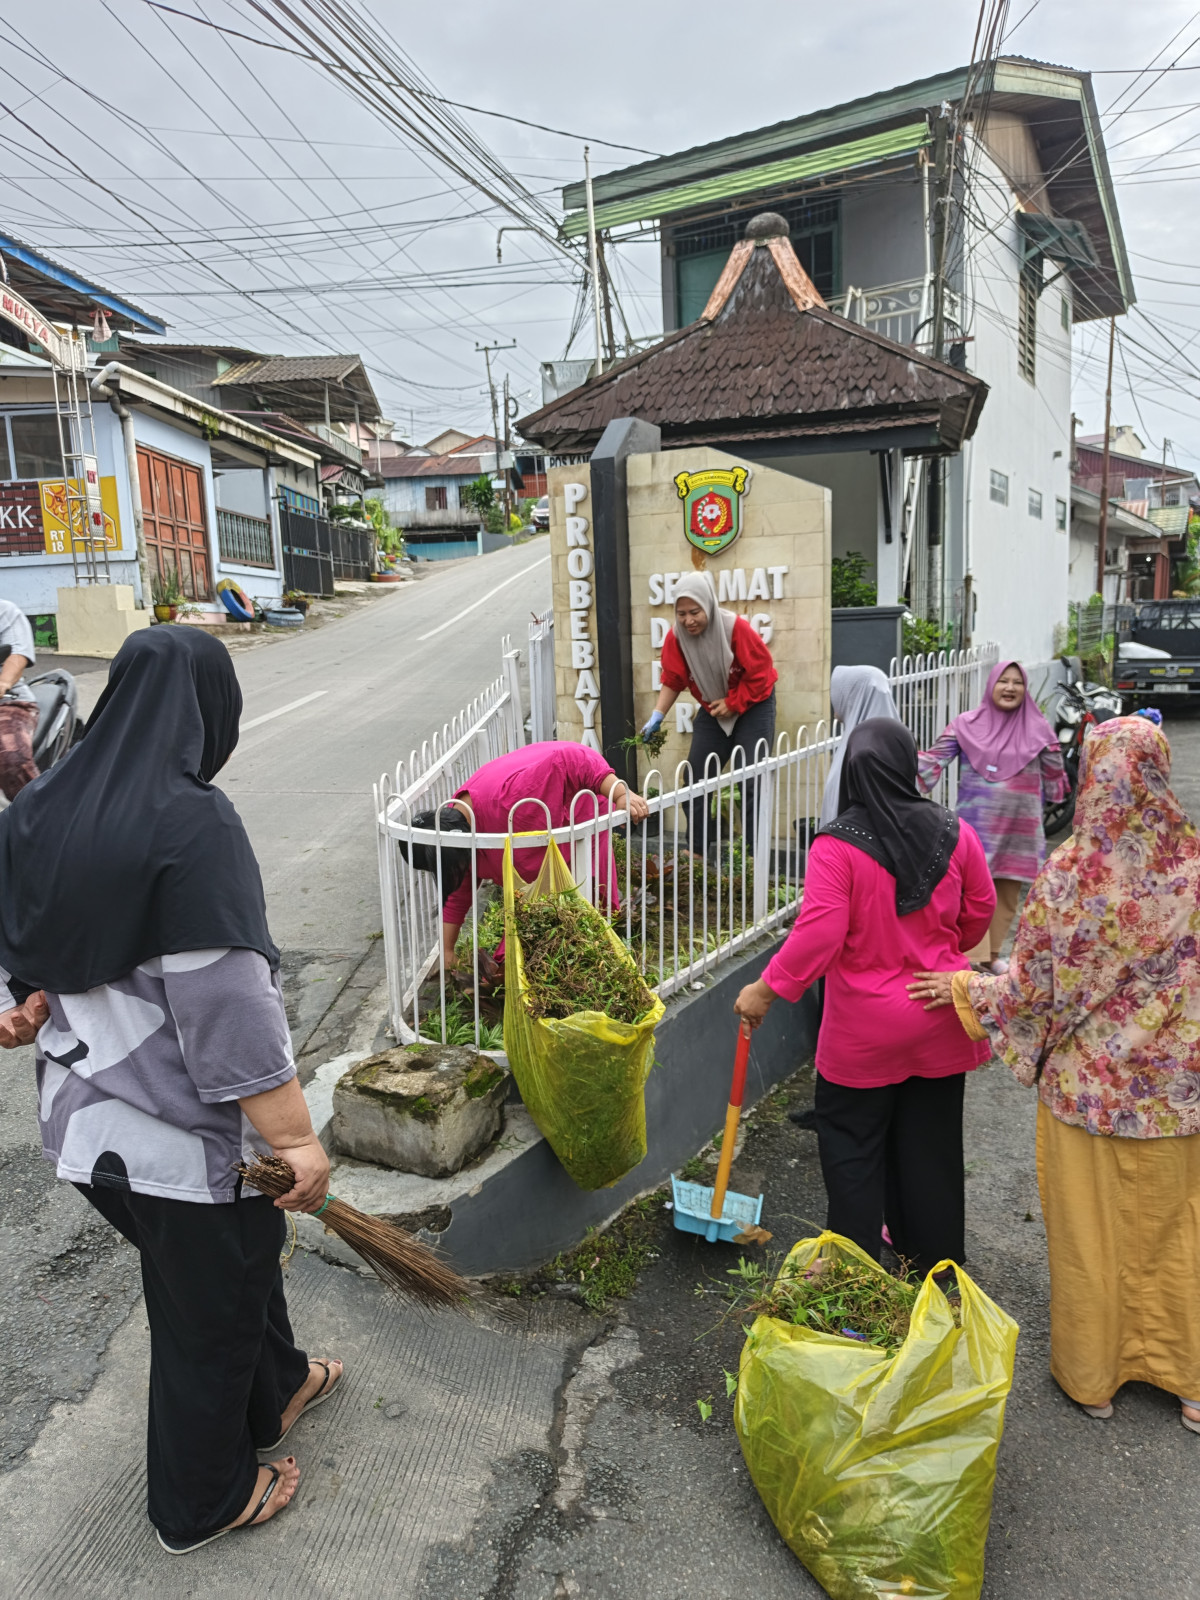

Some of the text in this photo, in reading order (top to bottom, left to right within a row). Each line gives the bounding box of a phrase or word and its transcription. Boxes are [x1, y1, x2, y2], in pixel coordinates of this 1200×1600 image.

[3, 294, 48, 343] MULYA
[50, 530, 65, 541] RT
[52, 541, 64, 552] 18
[648, 565, 788, 606] SEMAT
[564, 483, 600, 750] PROBEBAYA
